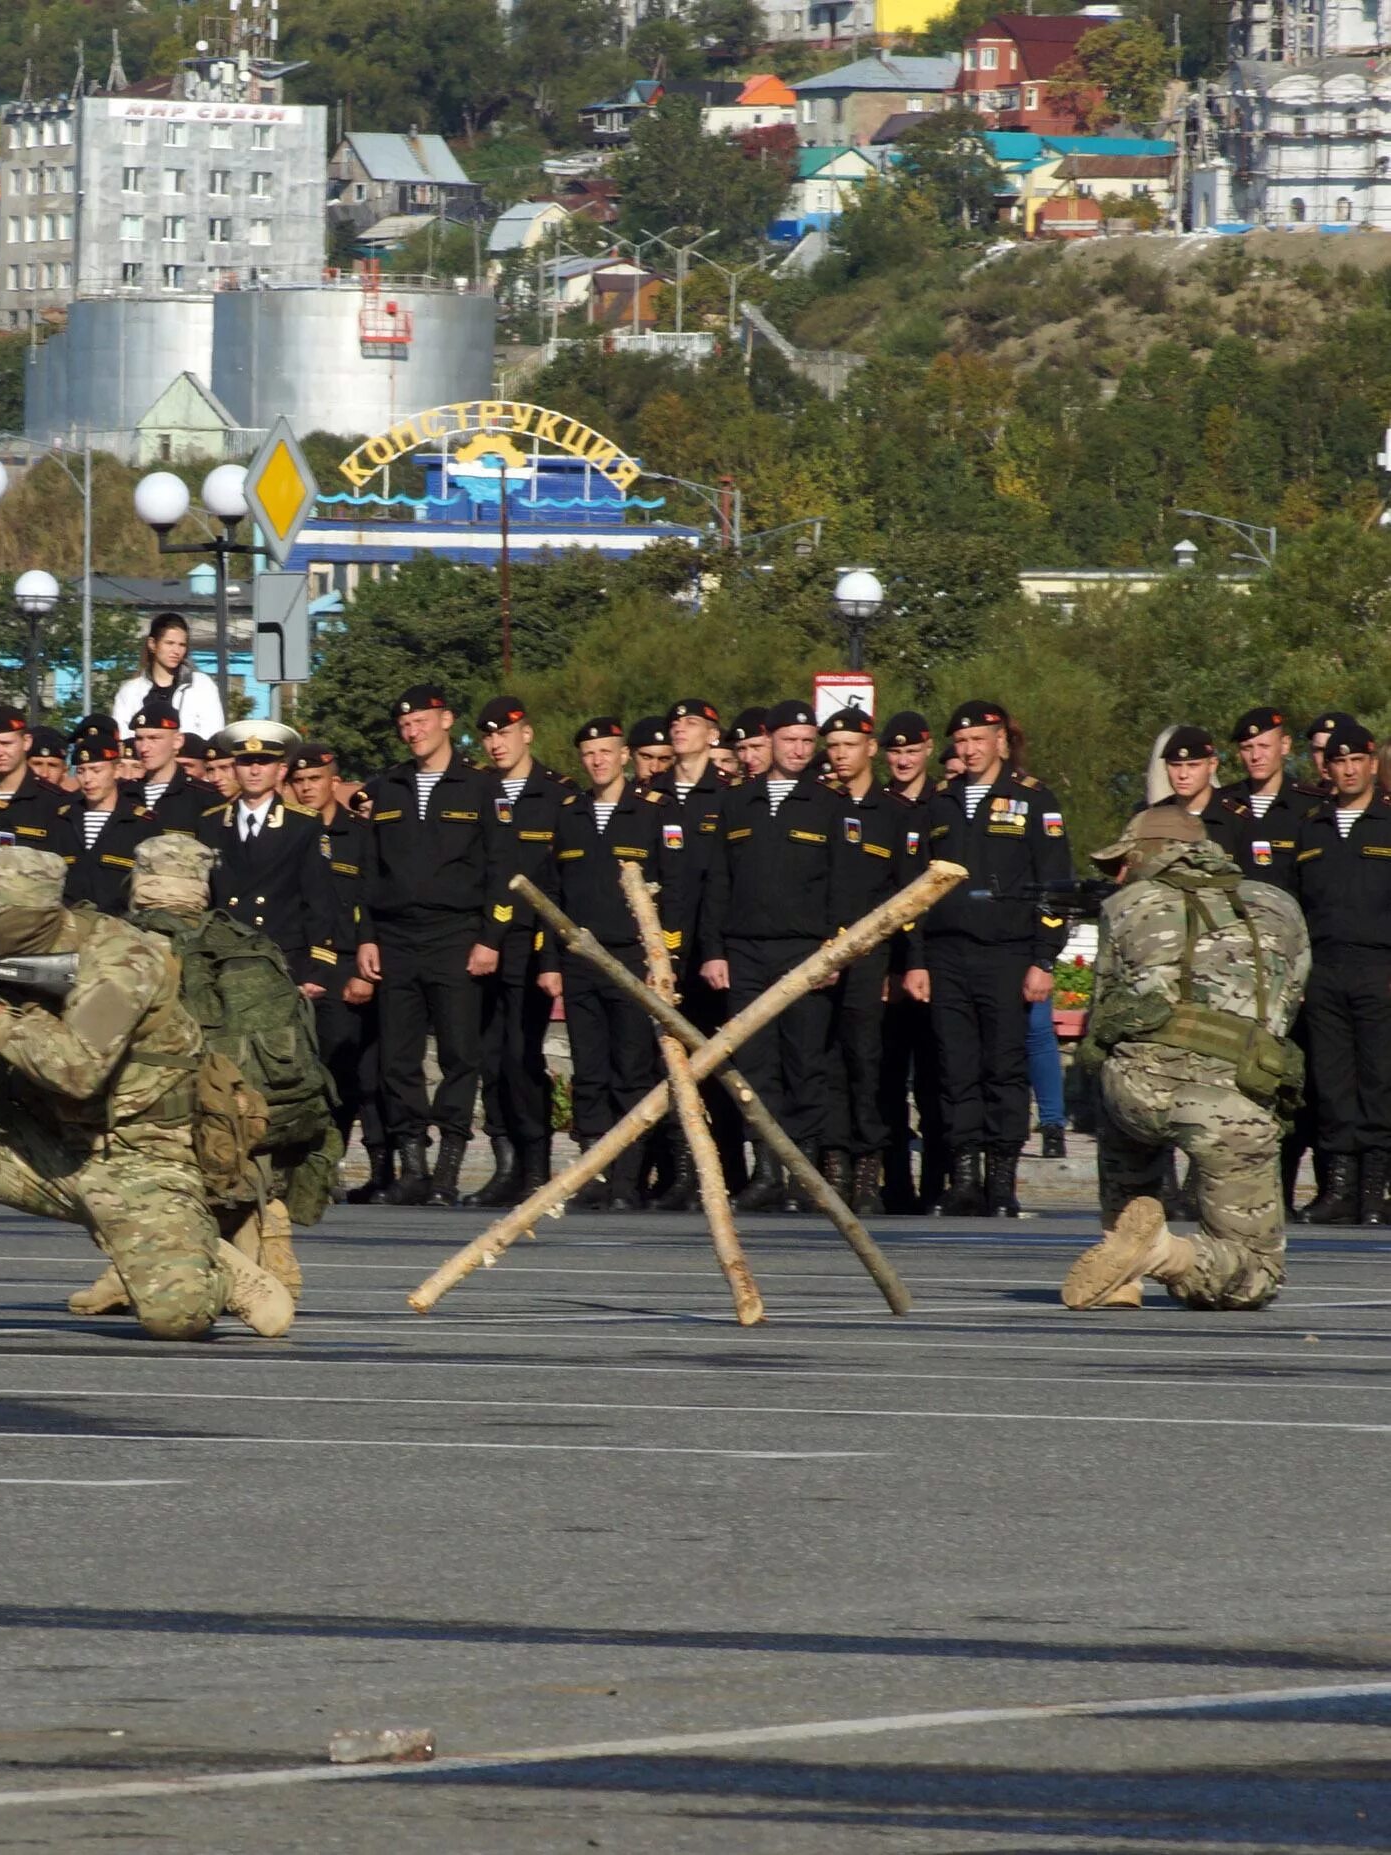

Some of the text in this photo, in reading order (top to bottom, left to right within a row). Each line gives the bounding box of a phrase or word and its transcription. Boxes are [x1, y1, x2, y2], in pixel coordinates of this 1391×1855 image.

[125, 103, 287, 121] МИР СВЯЗИ
[338, 401, 641, 491] КОНСТРУКЦИЯ
